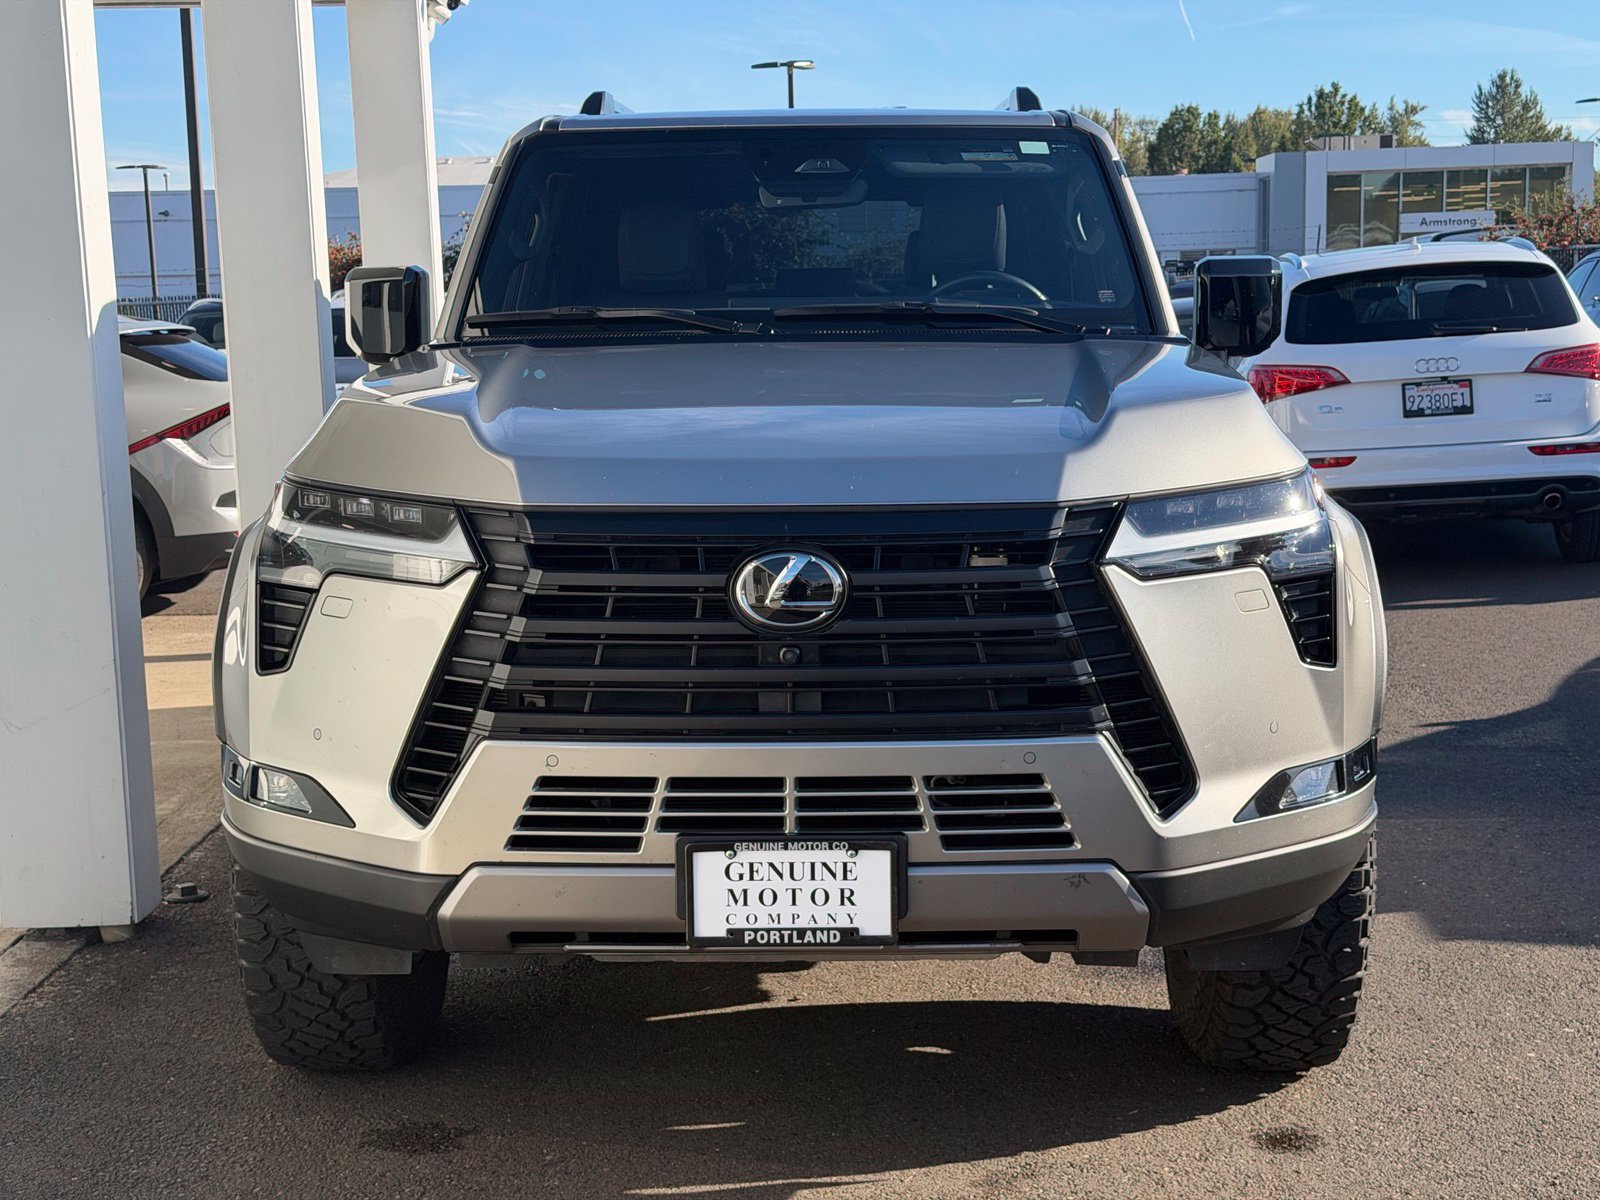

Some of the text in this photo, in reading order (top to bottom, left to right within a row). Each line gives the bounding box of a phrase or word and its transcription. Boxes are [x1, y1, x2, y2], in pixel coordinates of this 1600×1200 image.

[1407, 392, 1466, 411] 92380E1
[734, 842, 849, 850] GENUINE MOTOR CO
[724, 861, 858, 882] GENUINE
[725, 887, 858, 907] MOTOR
[725, 913, 858, 925] COMPANY
[744, 931, 841, 944] PORTLAND
